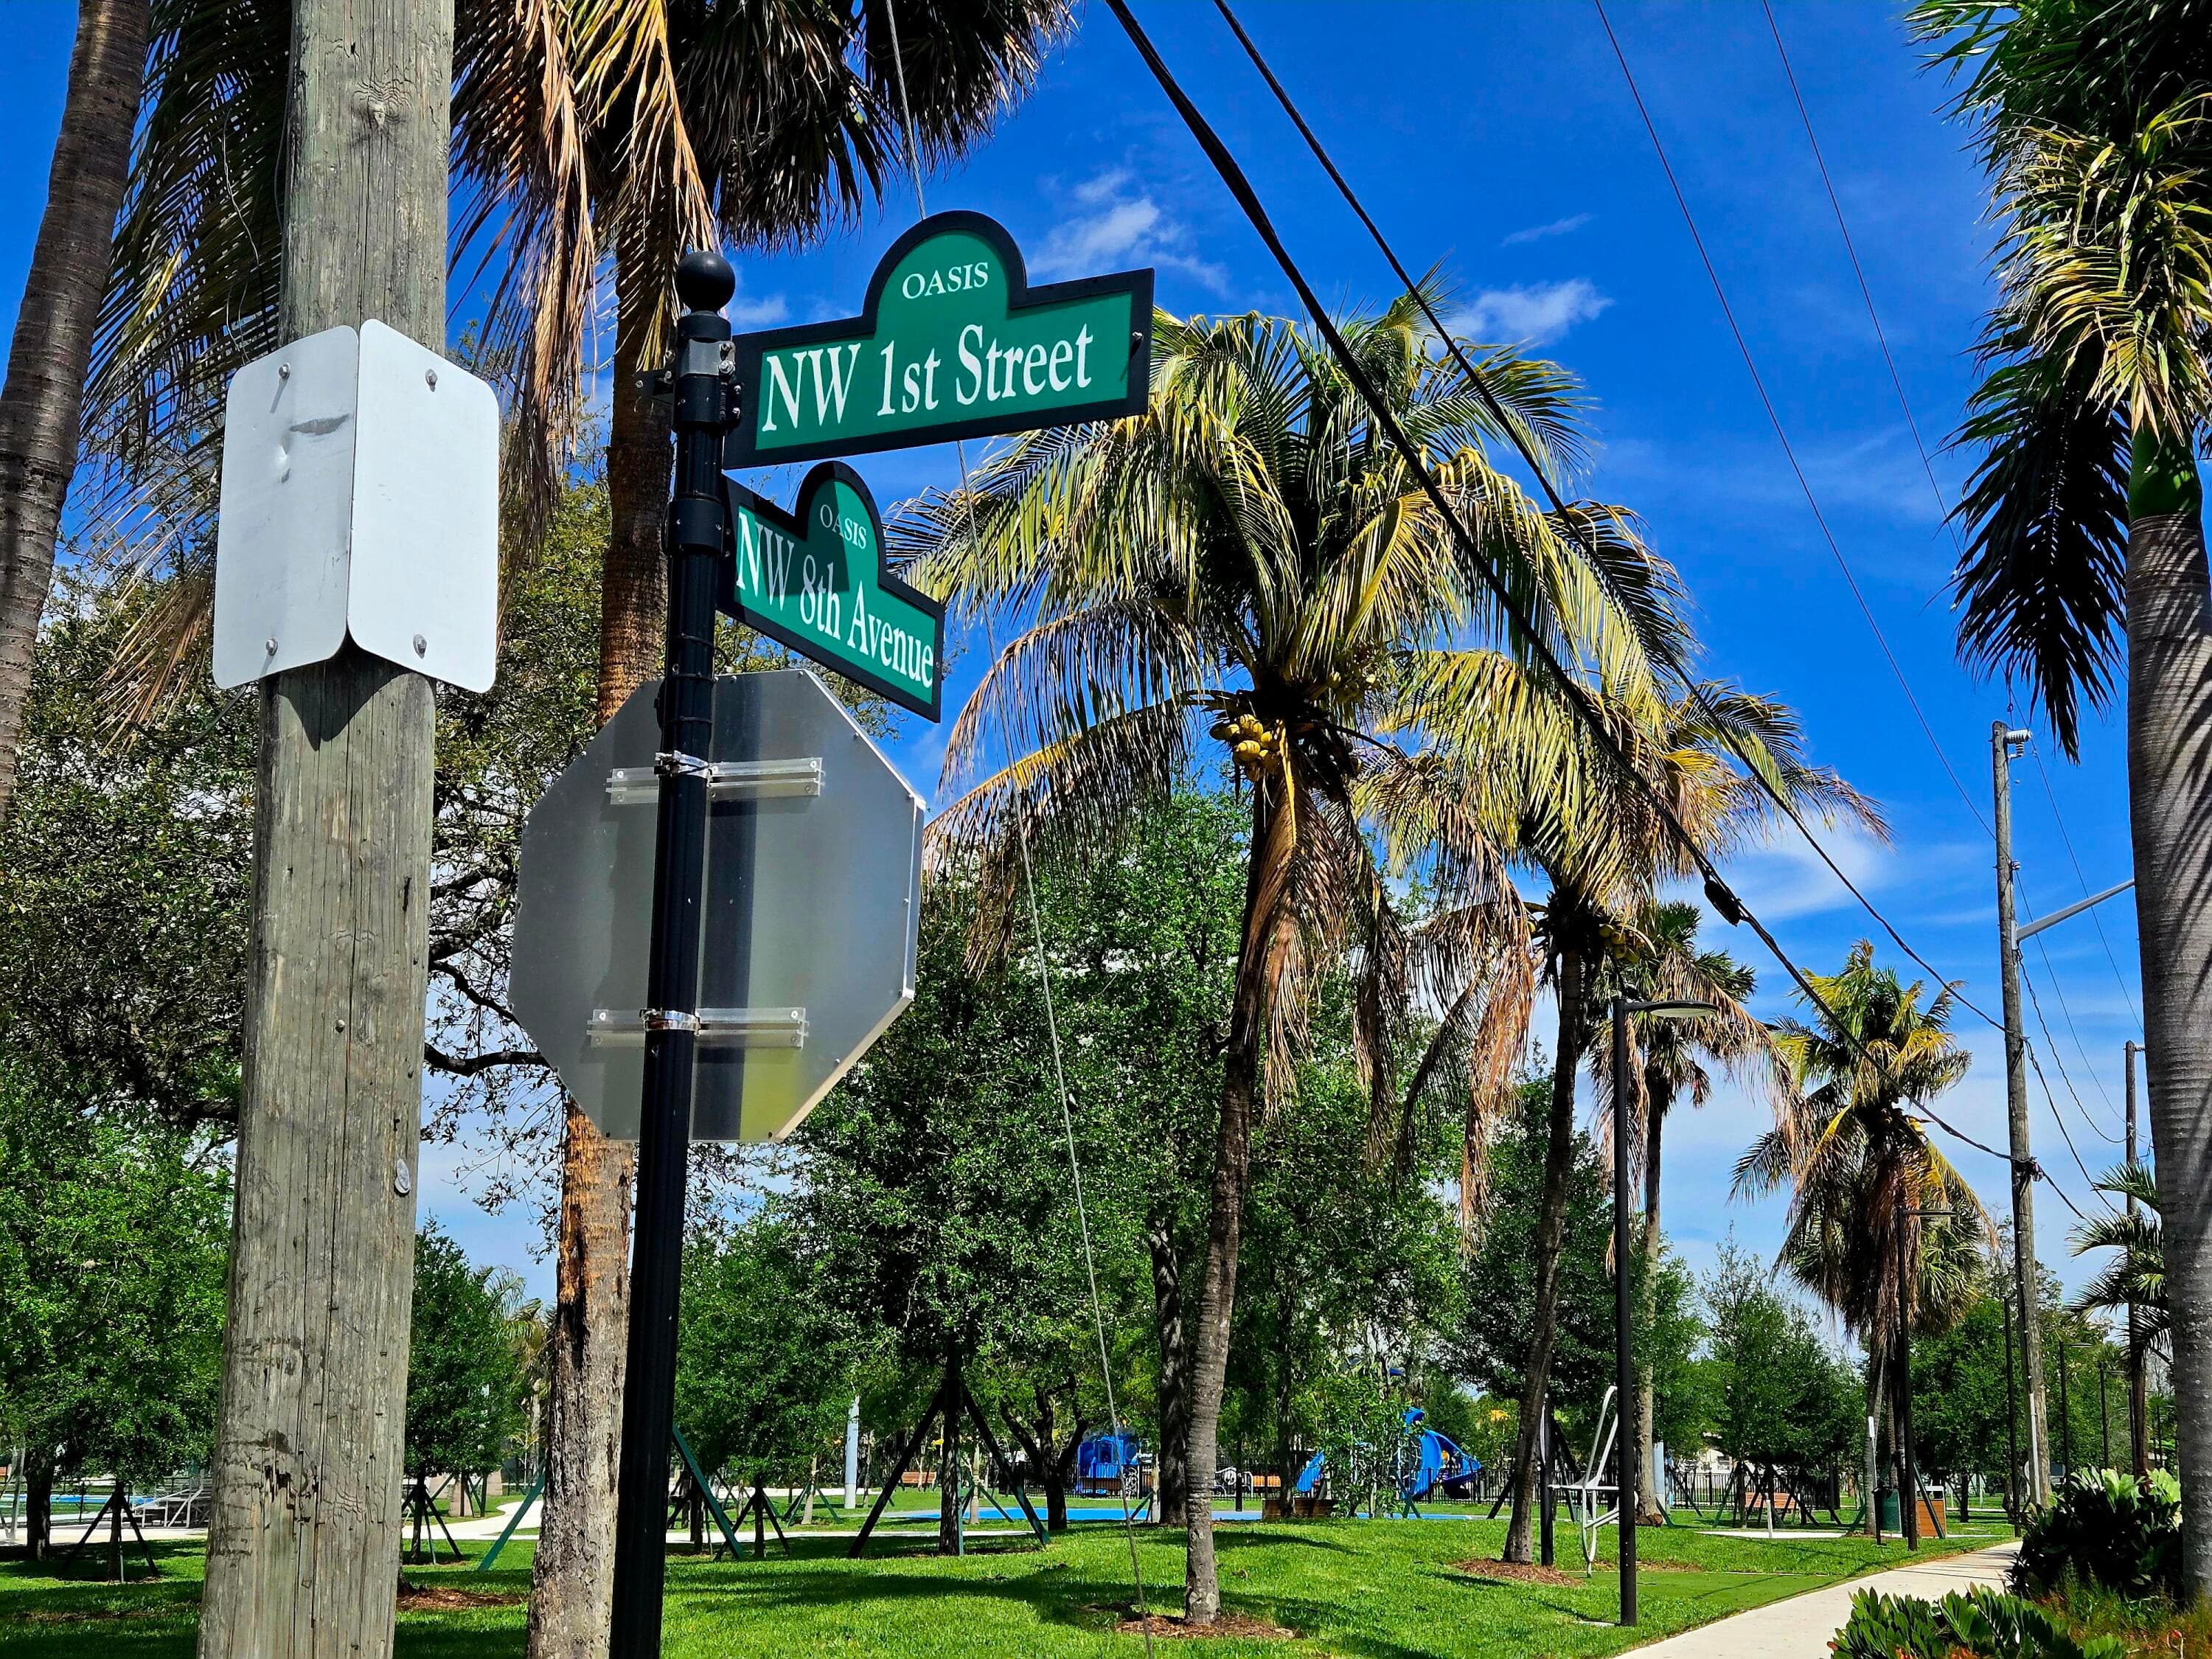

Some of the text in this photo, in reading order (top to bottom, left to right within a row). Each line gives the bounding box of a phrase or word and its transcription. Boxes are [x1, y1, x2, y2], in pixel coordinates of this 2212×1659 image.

[902, 261, 989, 300] OASIS
[762, 323, 1094, 432] NW 1st Street
[820, 504, 867, 549] OASIS
[736, 512, 933, 688] NW 8th Avenue
